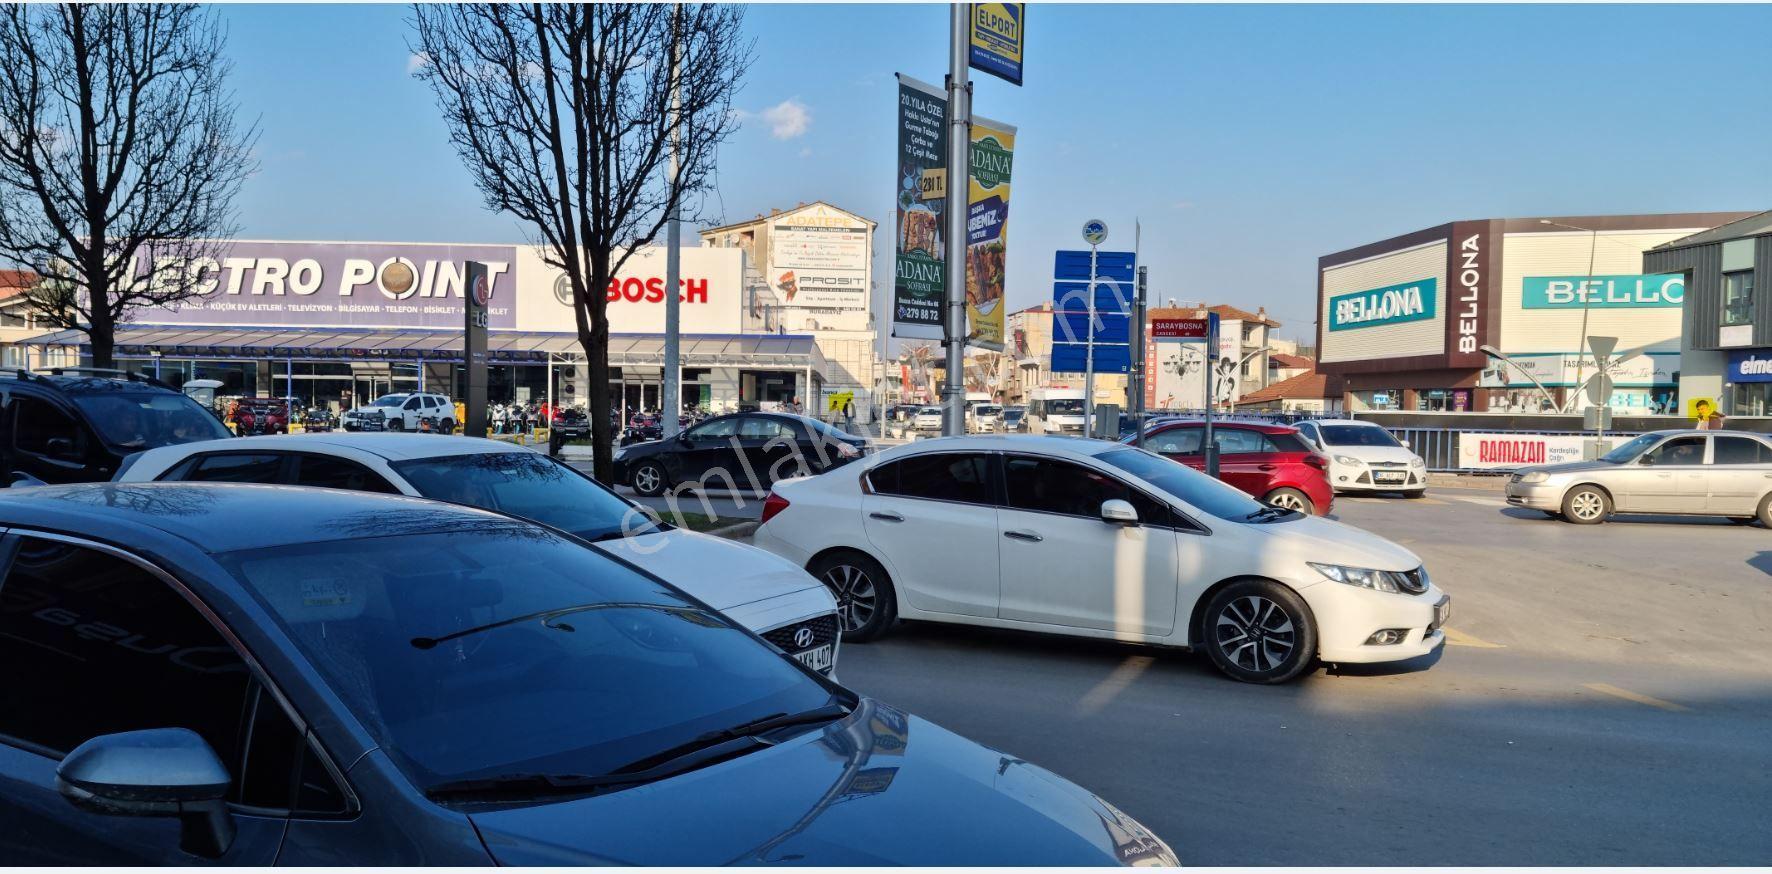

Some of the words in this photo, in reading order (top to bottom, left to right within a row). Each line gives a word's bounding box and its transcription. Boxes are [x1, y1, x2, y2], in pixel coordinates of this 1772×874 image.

[979, 9, 1015, 37] ELPORT
[901, 93, 926, 112] 20.YILA
[927, 100, 944, 118] ÖZEL
[904, 120, 922, 133] Gurme
[905, 144, 912, 153] 12
[910, 134, 926, 145] Çorba
[969, 148, 1010, 174] ADANA
[936, 176, 943, 191] TL
[786, 216, 852, 227] ADATEPE
[967, 209, 997, 232] UBEMİZ
[339, 256, 509, 300] POINT
[799, 276, 864, 285] PROSIT
[895, 259, 941, 283] ADANA
[1458, 234, 1479, 354] BELLONA
[1545, 278, 1684, 304] BELLO
[210, 302, 236, 312] KÜÇÜK
[287, 303, 333, 312] TELEVİZYON
[338, 304, 380, 313] BİLGİSAYAR
[385, 305, 418, 313] TELEFON
[424, 305, 456, 314] BİSİKLET
[906, 307, 919, 319] 279
[920, 308, 929, 320] 88
[930, 310, 938, 321] 72
[1336, 286, 1424, 325] BELLONA
[476, 310, 488, 328] LG
[1155, 322, 1203, 330] SARAYBOSNA
[1479, 440, 1545, 463] RAMAZAN
[816, 647, 830, 667] 407
